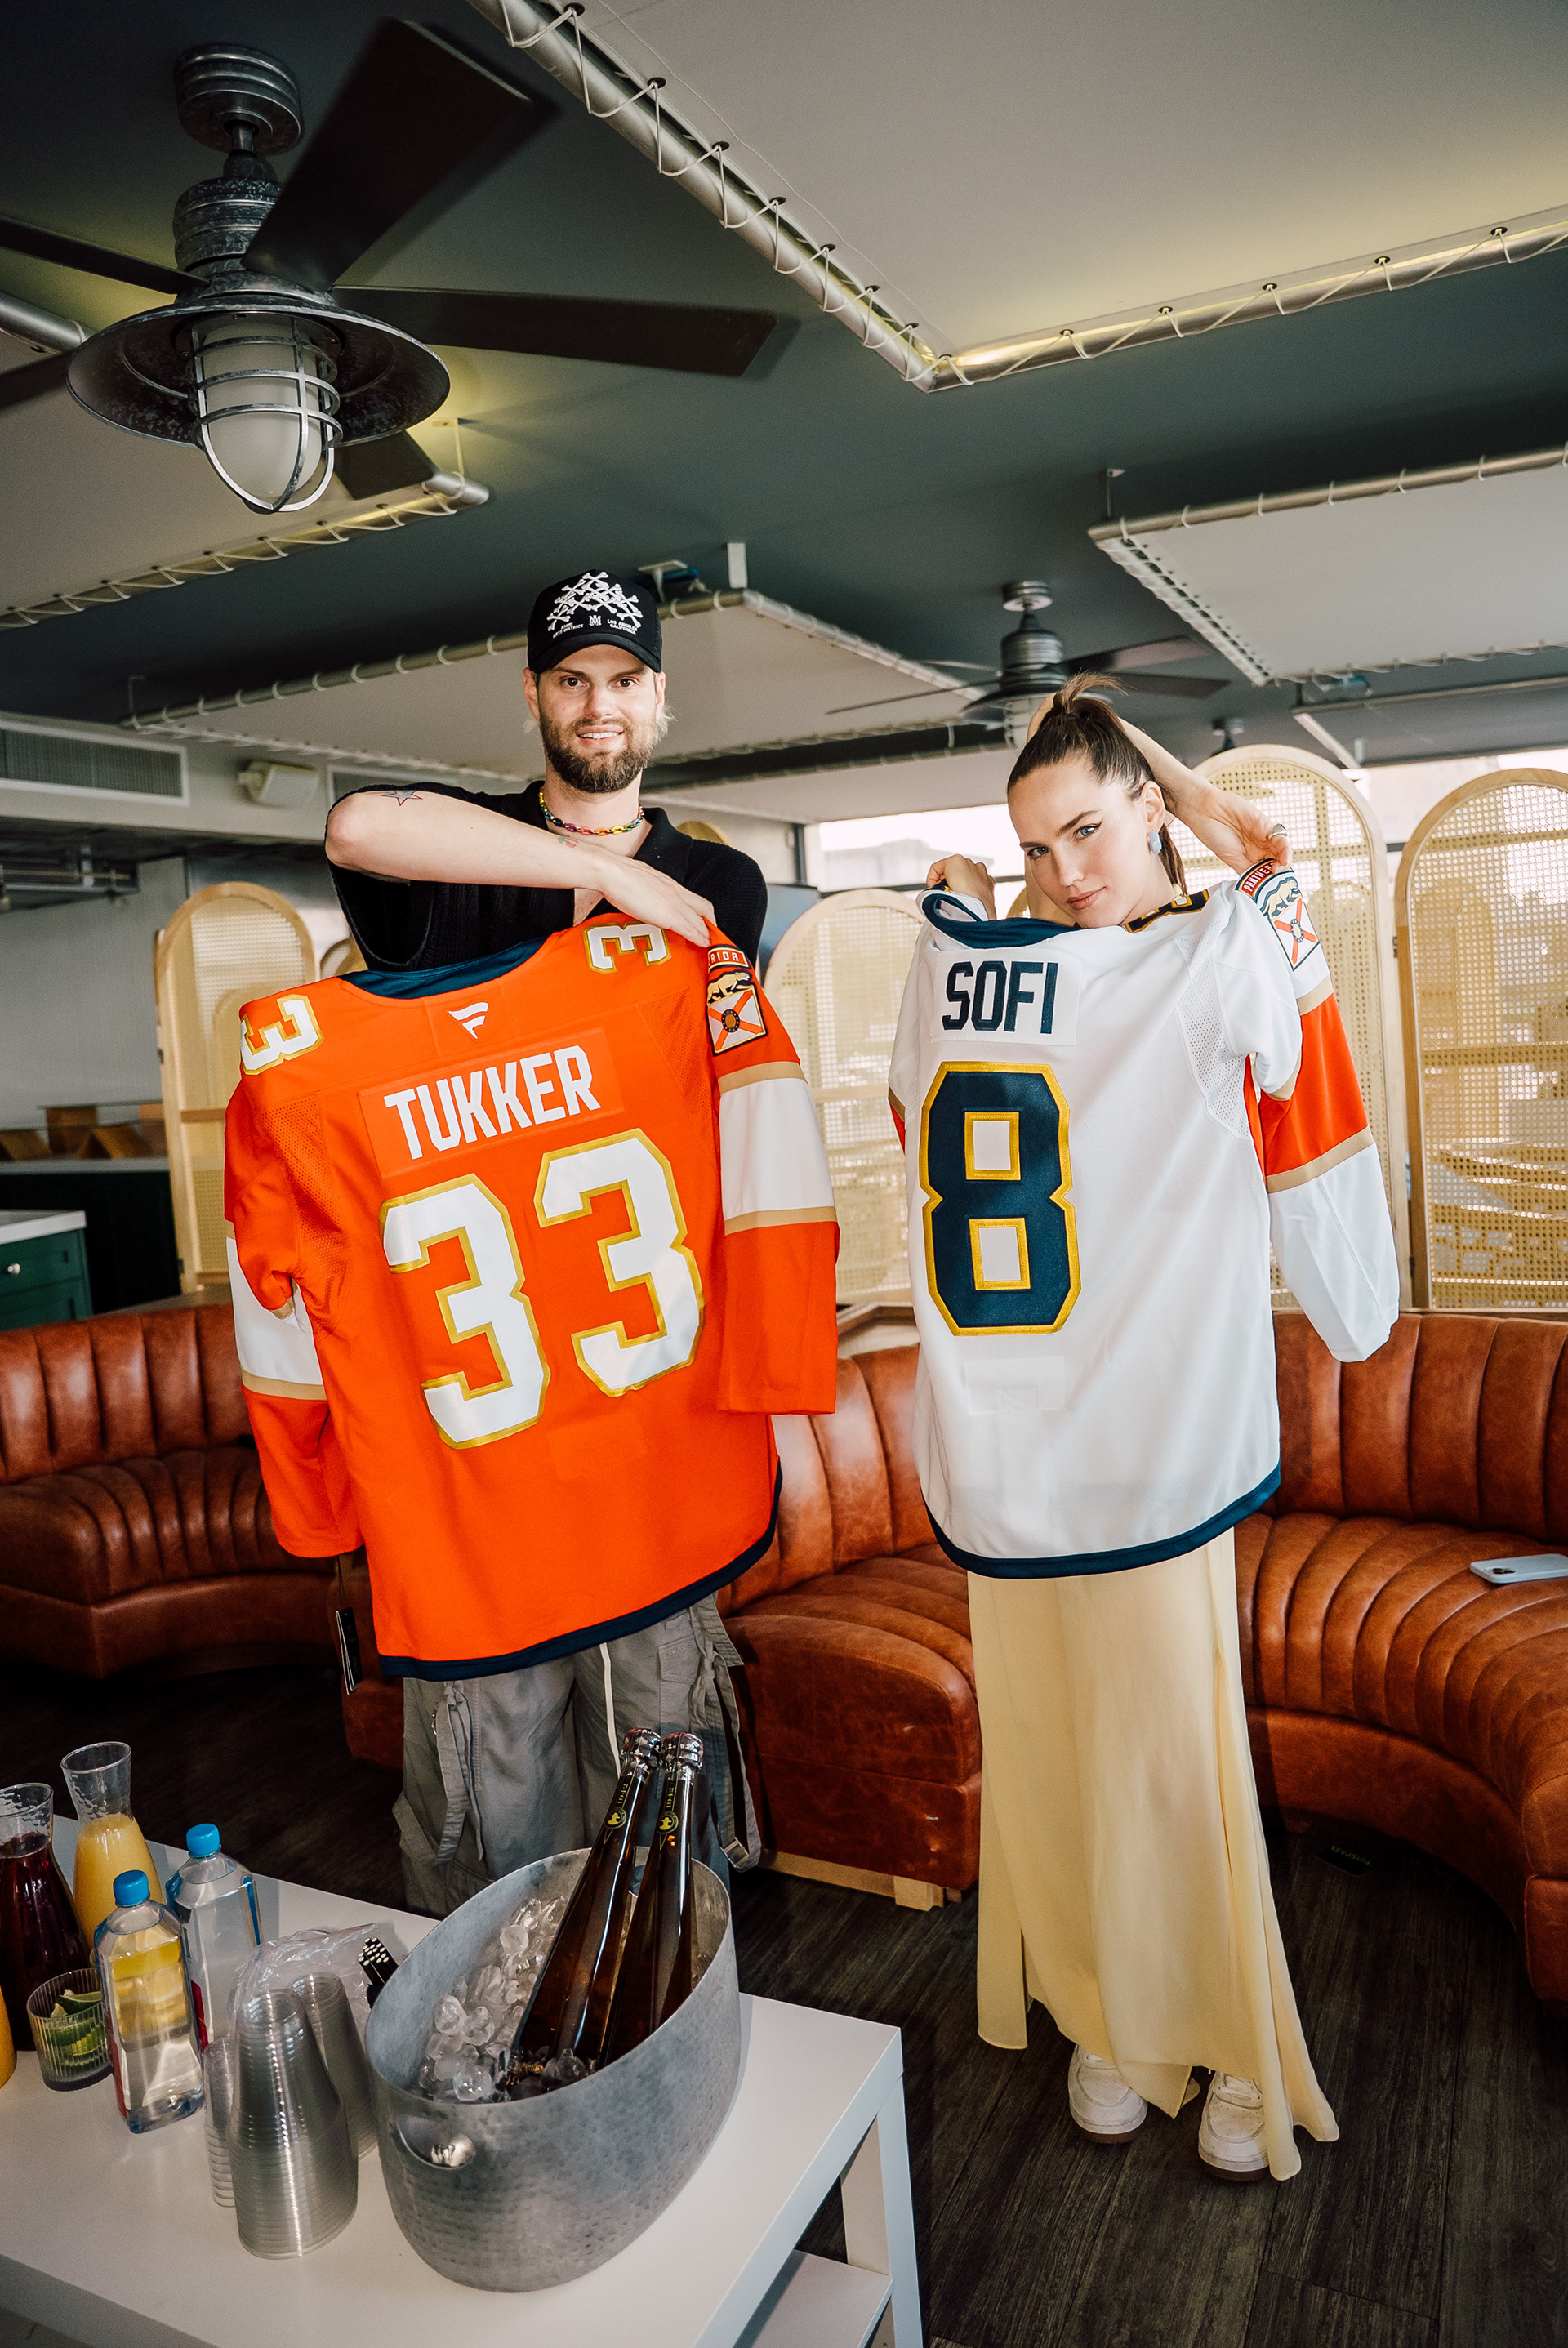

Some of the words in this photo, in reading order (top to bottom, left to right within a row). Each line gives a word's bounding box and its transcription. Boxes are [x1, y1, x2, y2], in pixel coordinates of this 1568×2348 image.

[609, 623, 637, 635] CALIFORNIA
[1243, 862, 1274, 892] PANTHER
[708, 951, 739, 966] RIDA
[942, 960, 1059, 1035] SOFI
[385, 1045, 601, 1160] TUKKER
[919, 1061, 1081, 1337] 8
[379, 1128, 705, 1450] 33
[617, 1783, 629, 1804] 1942
[666, 1787, 675, 1808] 1942
